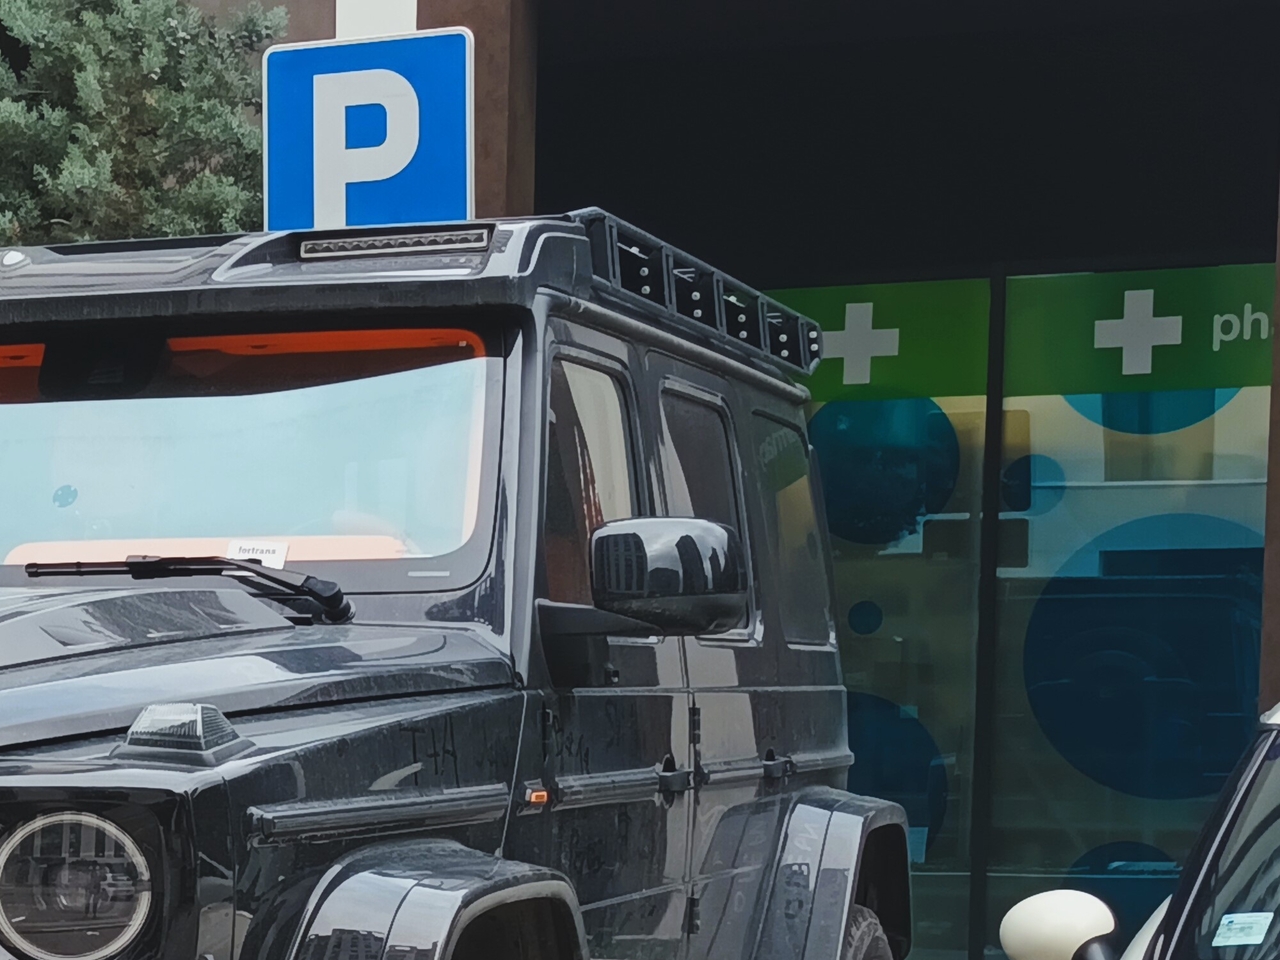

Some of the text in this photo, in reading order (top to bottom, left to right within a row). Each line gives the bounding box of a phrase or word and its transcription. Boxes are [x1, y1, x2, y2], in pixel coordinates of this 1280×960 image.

[313, 69, 420, 229] P
[1212, 303, 1274, 351] ph
[238, 546, 276, 555] fortrans
